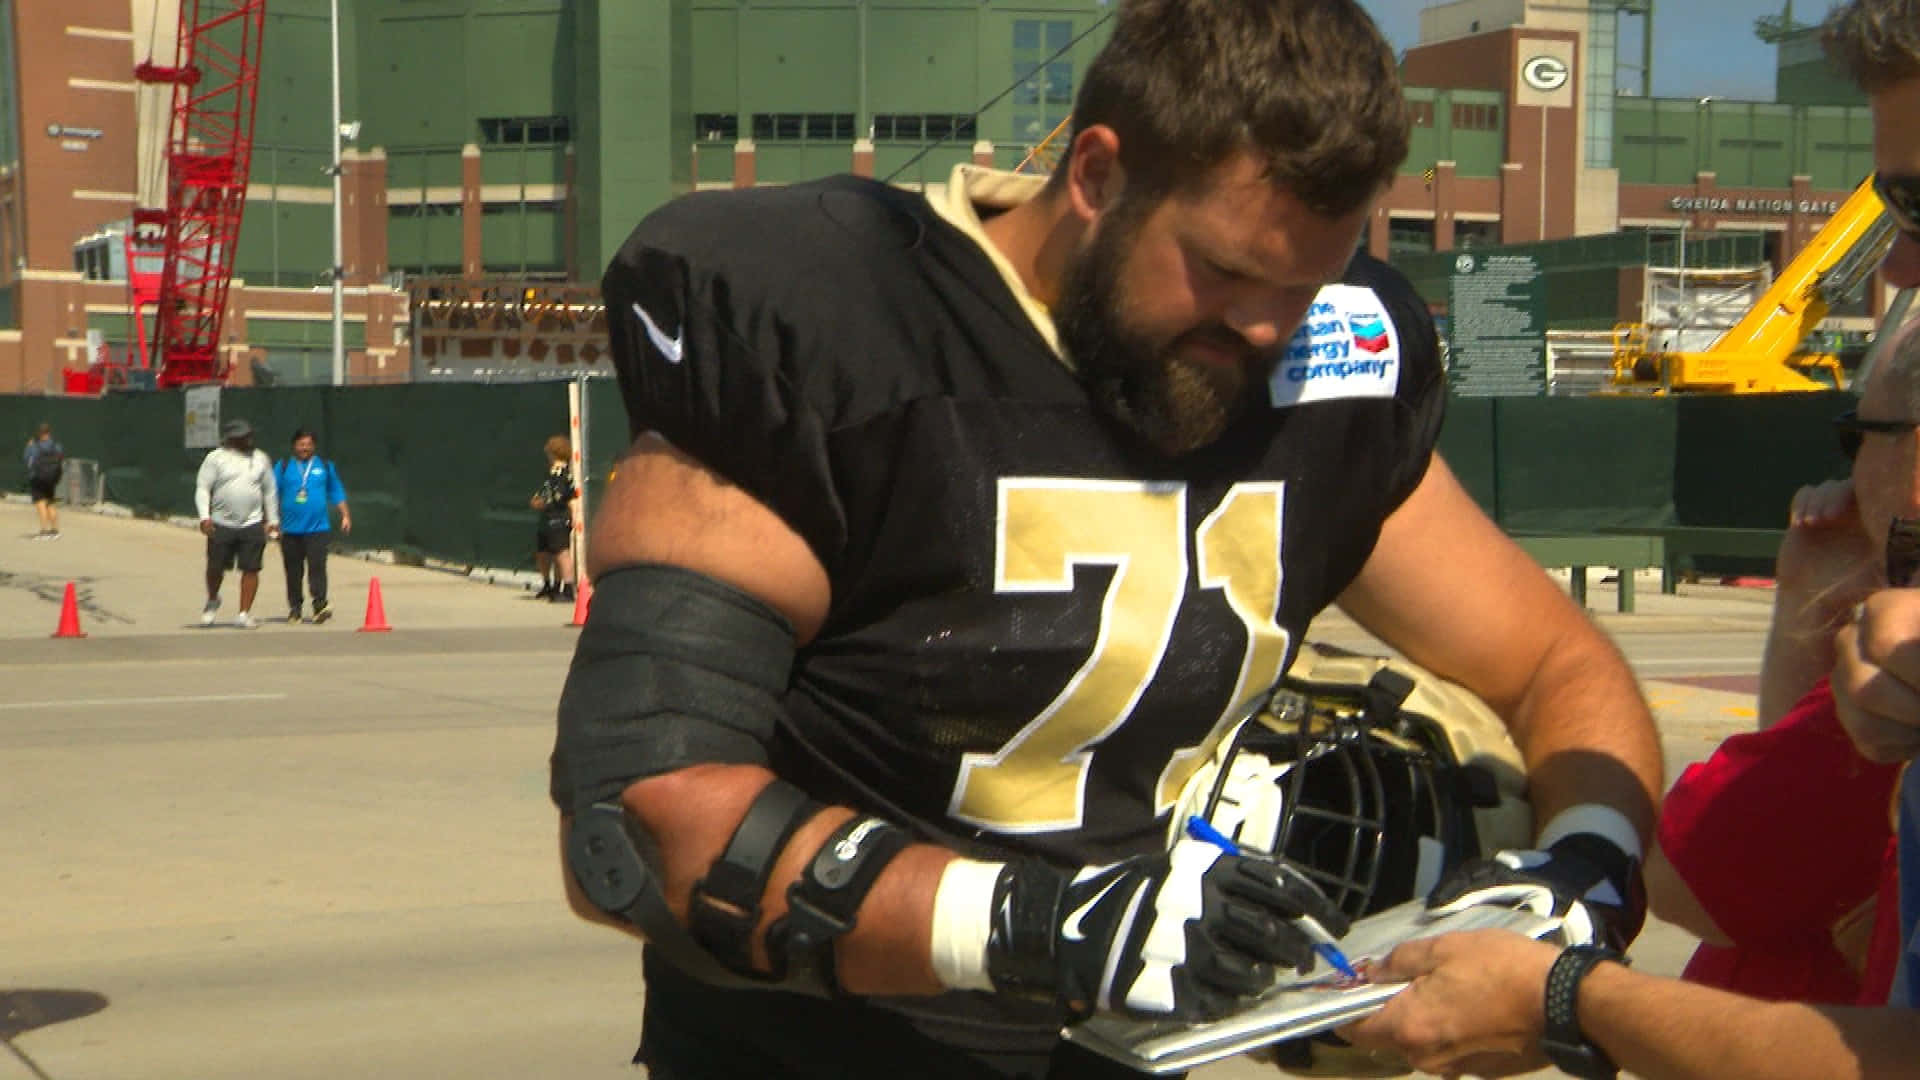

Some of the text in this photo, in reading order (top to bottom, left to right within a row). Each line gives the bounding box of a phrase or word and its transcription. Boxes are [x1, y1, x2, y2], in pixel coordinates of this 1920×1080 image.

[1523, 56, 1568, 91] G
[1671, 195, 1838, 214] ONEIDA NATION GATE
[1307, 302, 1336, 317] he
[1285, 340, 1350, 360] nergy
[1287, 360, 1388, 383] company
[947, 475, 1290, 834] 71
